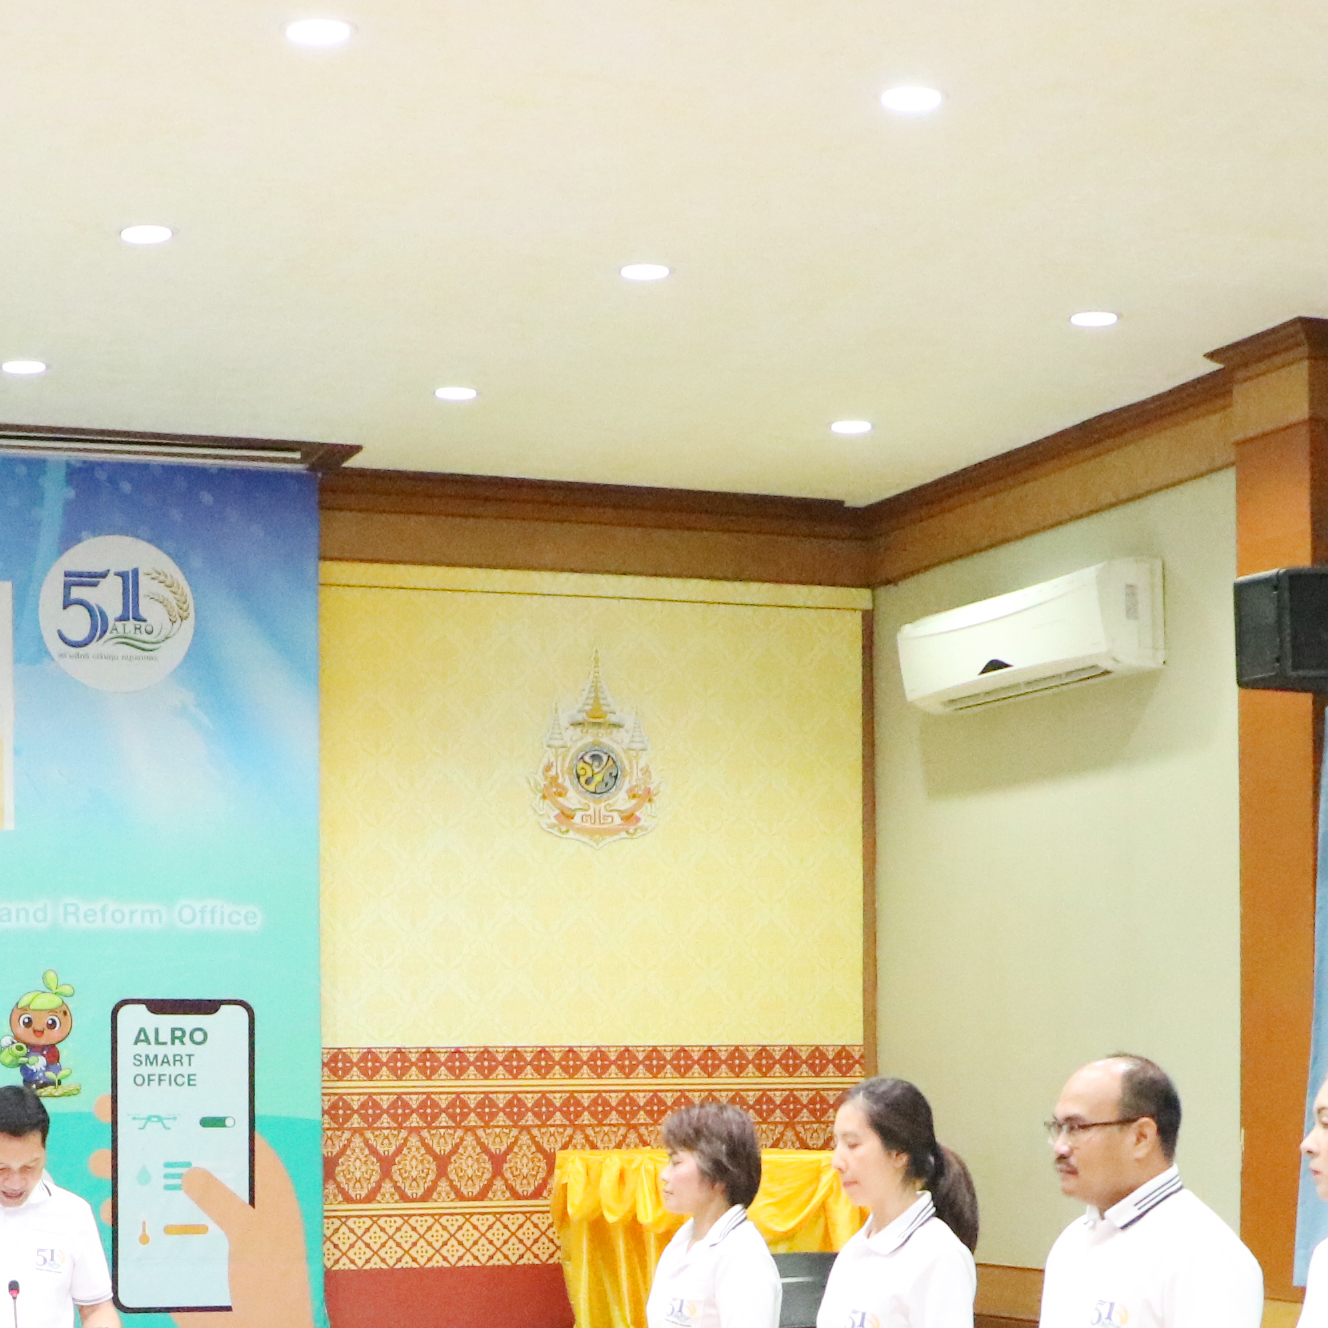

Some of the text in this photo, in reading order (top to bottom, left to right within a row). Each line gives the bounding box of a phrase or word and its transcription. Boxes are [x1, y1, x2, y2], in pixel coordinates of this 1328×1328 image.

[57, 567, 147, 648] 51
[109, 623, 155, 636] ALRO
[63, 902, 163, 925] Reform
[177, 903, 258, 926] Office
[133, 1027, 208, 1046] ALRO
[133, 1054, 195, 1067] SMART
[133, 1074, 197, 1087] OFFICE
[36, 1248, 55, 1267] 51
